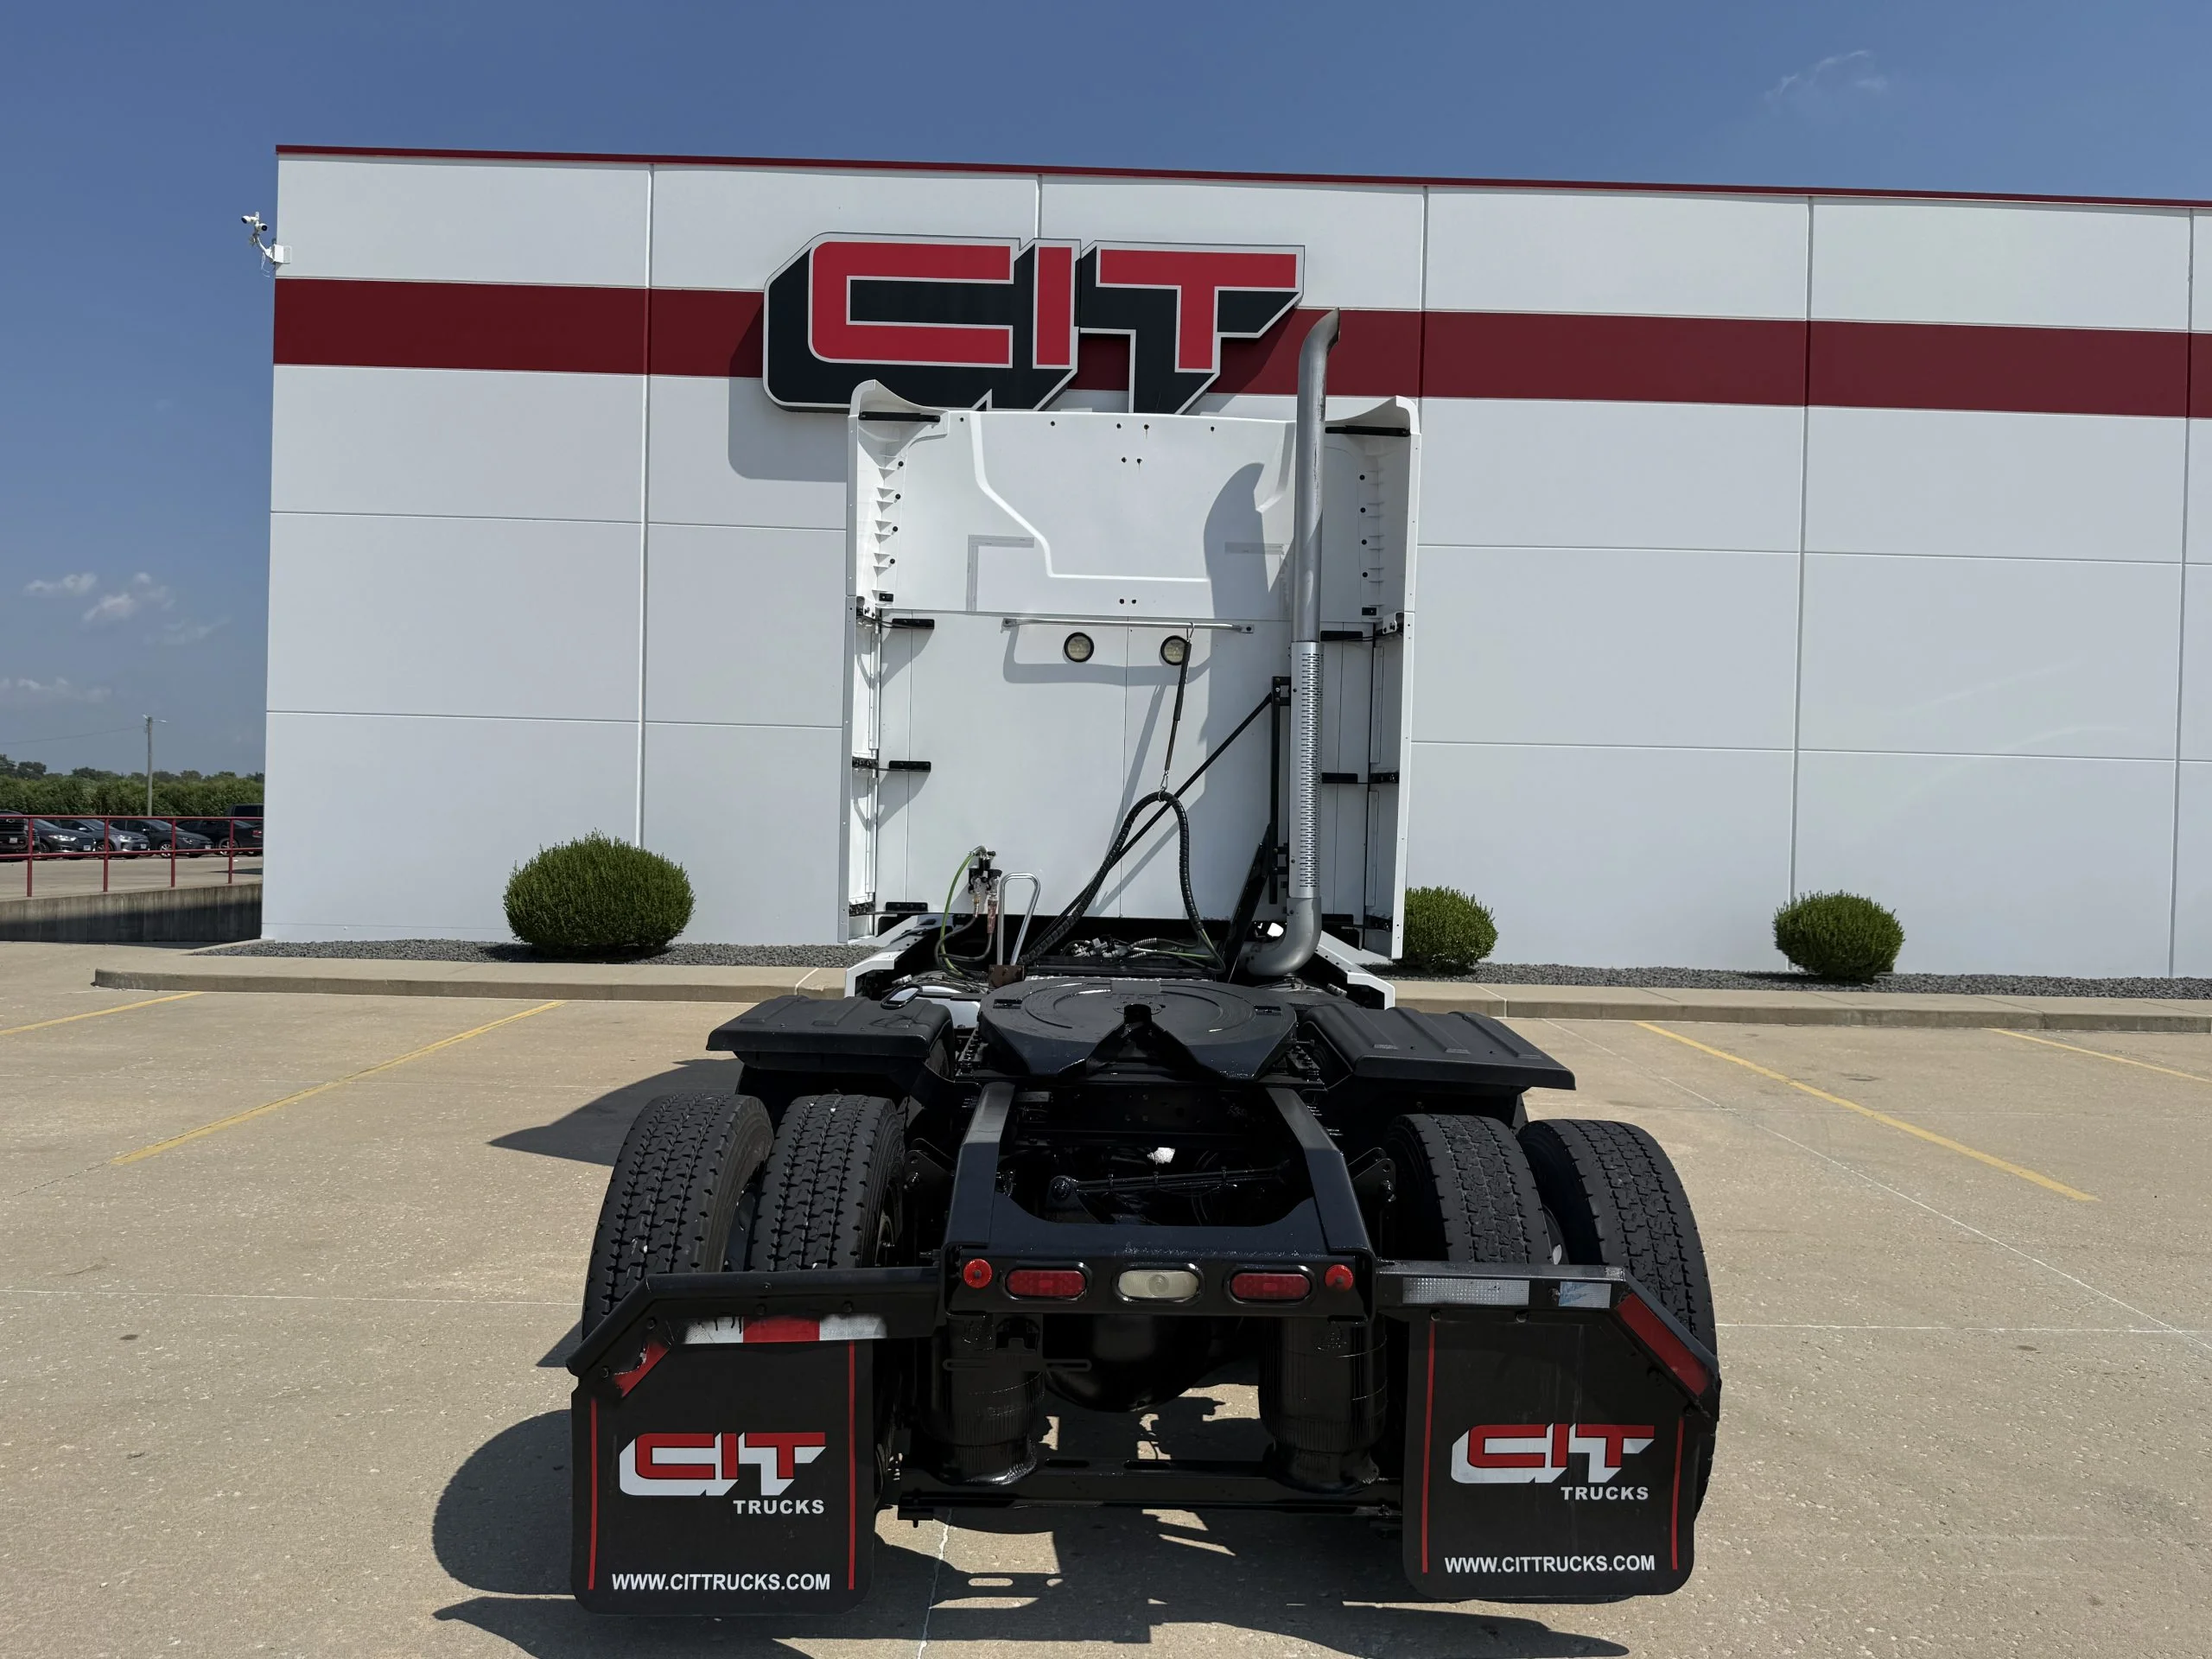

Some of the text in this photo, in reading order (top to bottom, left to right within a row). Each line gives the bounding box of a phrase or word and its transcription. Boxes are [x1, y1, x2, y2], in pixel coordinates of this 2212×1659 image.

[765, 232, 1305, 411] CIT
[1452, 1423, 1655, 1483] CIT
[620, 1432, 827, 1496] CIT
[1560, 1486, 1649, 1500] TRUCKS
[733, 1499, 824, 1515] TRUCKS
[1445, 1555, 1656, 1573] WWW.CITTRUCKS.COM
[612, 1573, 831, 1591] WWW.CITTRUCKS.COM
